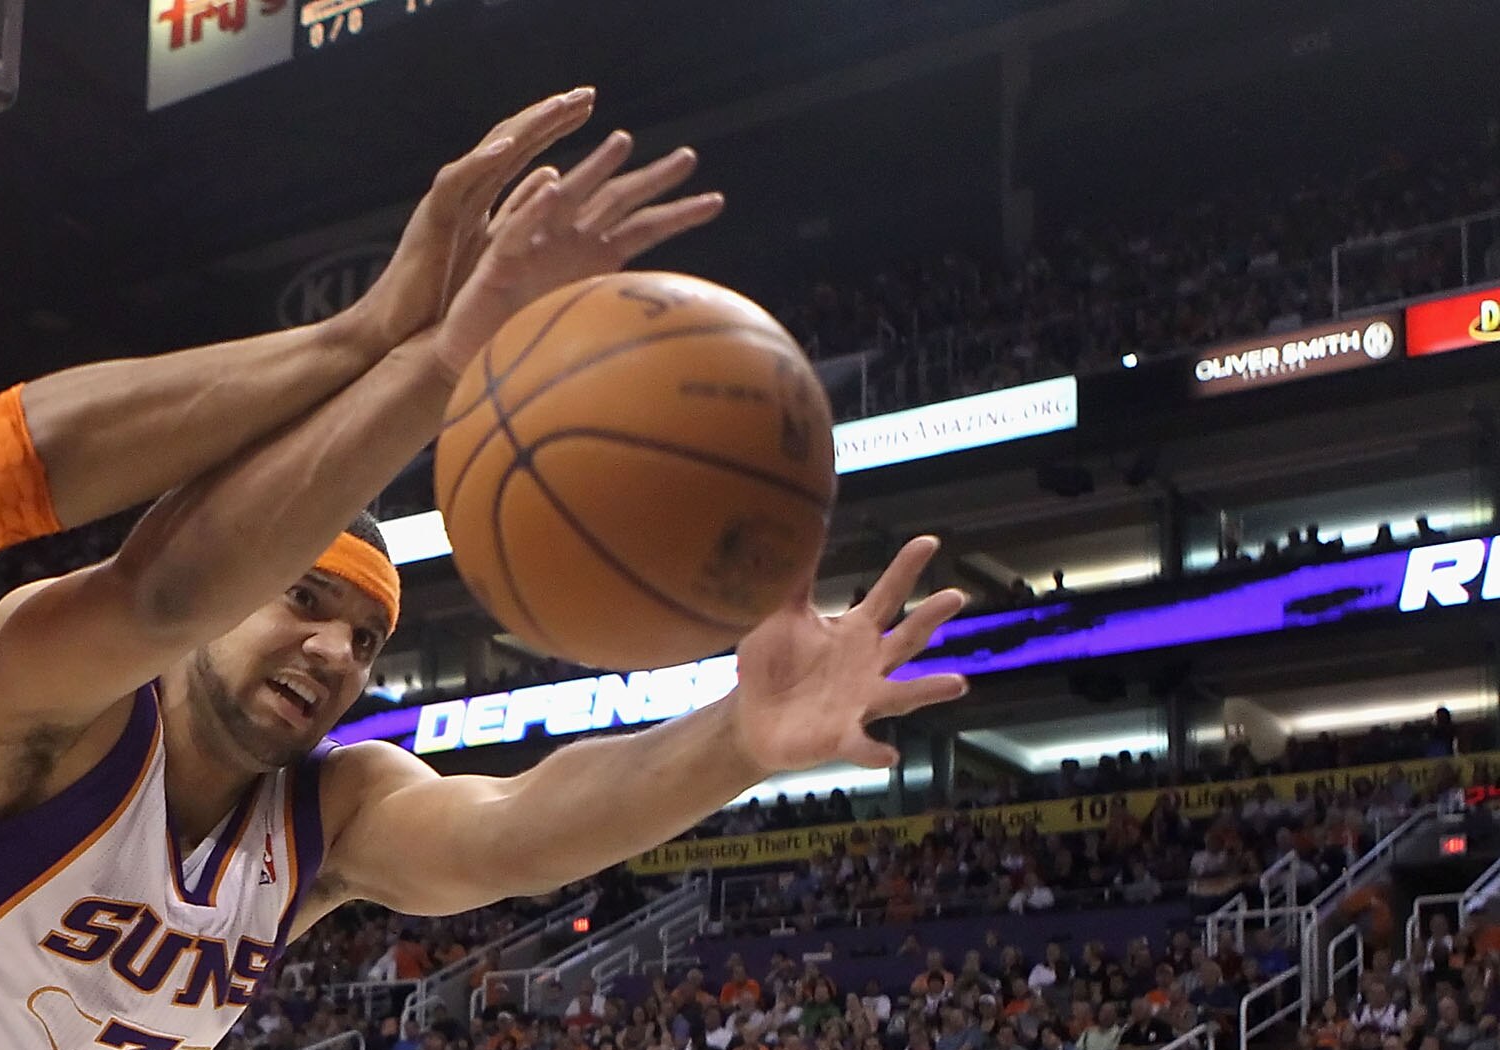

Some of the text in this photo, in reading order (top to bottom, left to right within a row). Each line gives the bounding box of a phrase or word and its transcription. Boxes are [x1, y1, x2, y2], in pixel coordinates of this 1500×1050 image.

[303, 264, 380, 323] KI
[1195, 346, 1280, 382] OLIVER
[1282, 329, 1361, 366] SMITH
[1399, 535, 1500, 612] R
[685, 840, 749, 863] Identity
[755, 835, 802, 855] Theft
[38, 896, 275, 1008] SUNS
